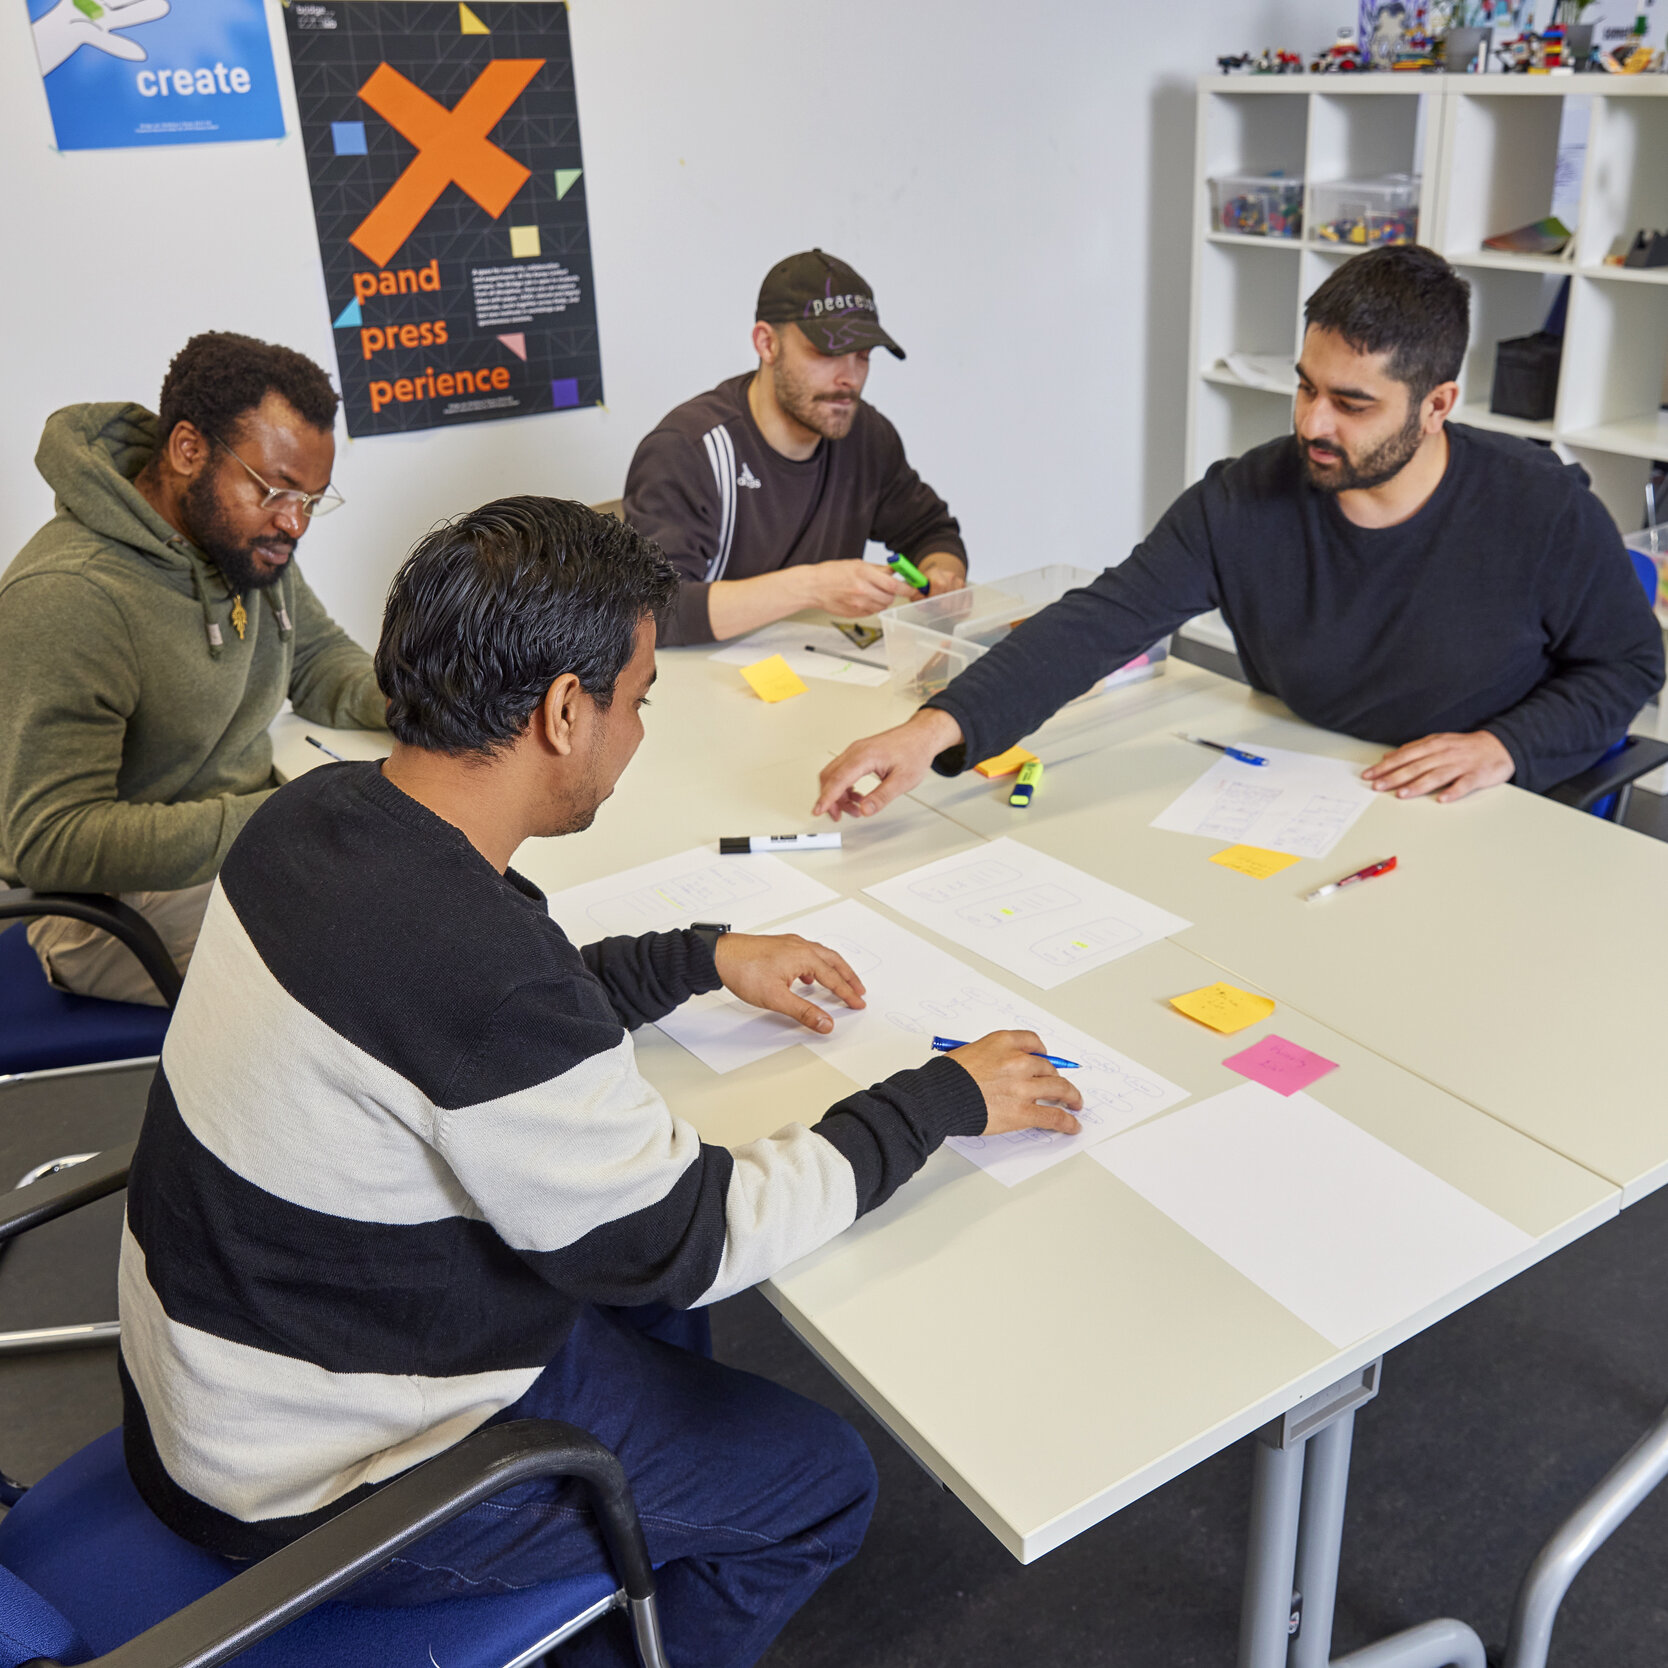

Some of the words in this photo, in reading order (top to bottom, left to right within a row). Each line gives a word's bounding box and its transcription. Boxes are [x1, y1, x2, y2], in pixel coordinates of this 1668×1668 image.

[136, 61, 252, 98] create
[353, 259, 441, 305] pand
[360, 320, 449, 361] press
[368, 365, 511, 413] perience
